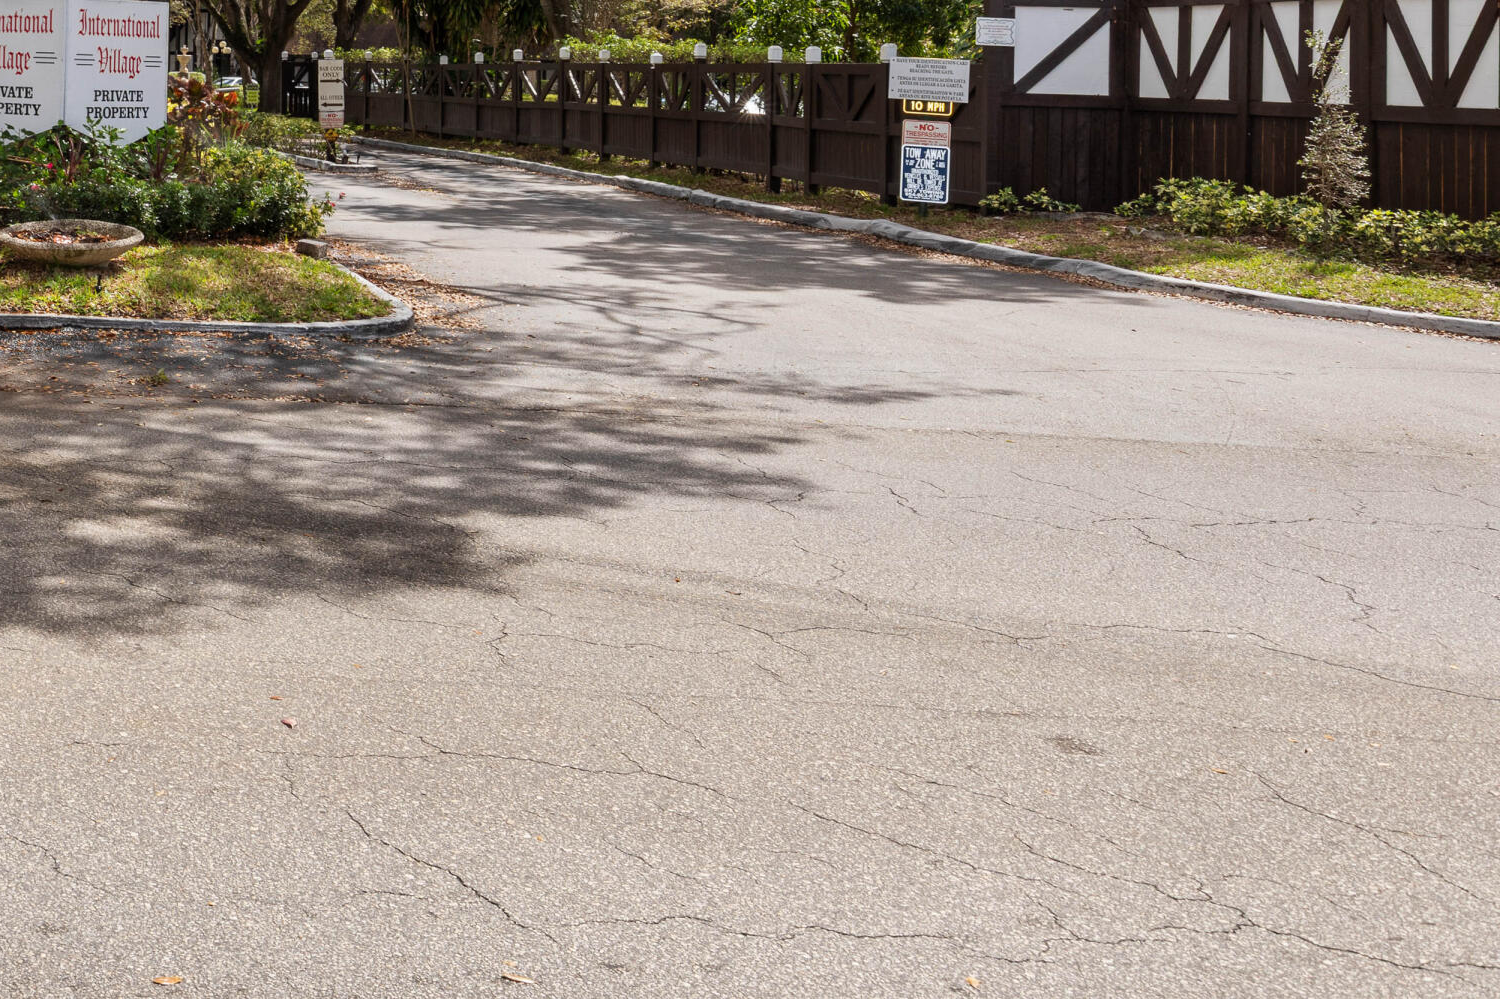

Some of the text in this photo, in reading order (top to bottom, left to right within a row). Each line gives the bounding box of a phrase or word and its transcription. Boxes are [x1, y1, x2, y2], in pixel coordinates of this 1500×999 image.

[78, 8, 160, 39] International
[98, 46, 143, 79] Village
[94, 90, 143, 102] PRIVATE
[86, 106, 150, 119] PROPERTY
[911, 101, 945, 112] 10 MPH
[906, 130, 947, 138] TRESPASSING
[915, 159, 935, 170] ZONE
